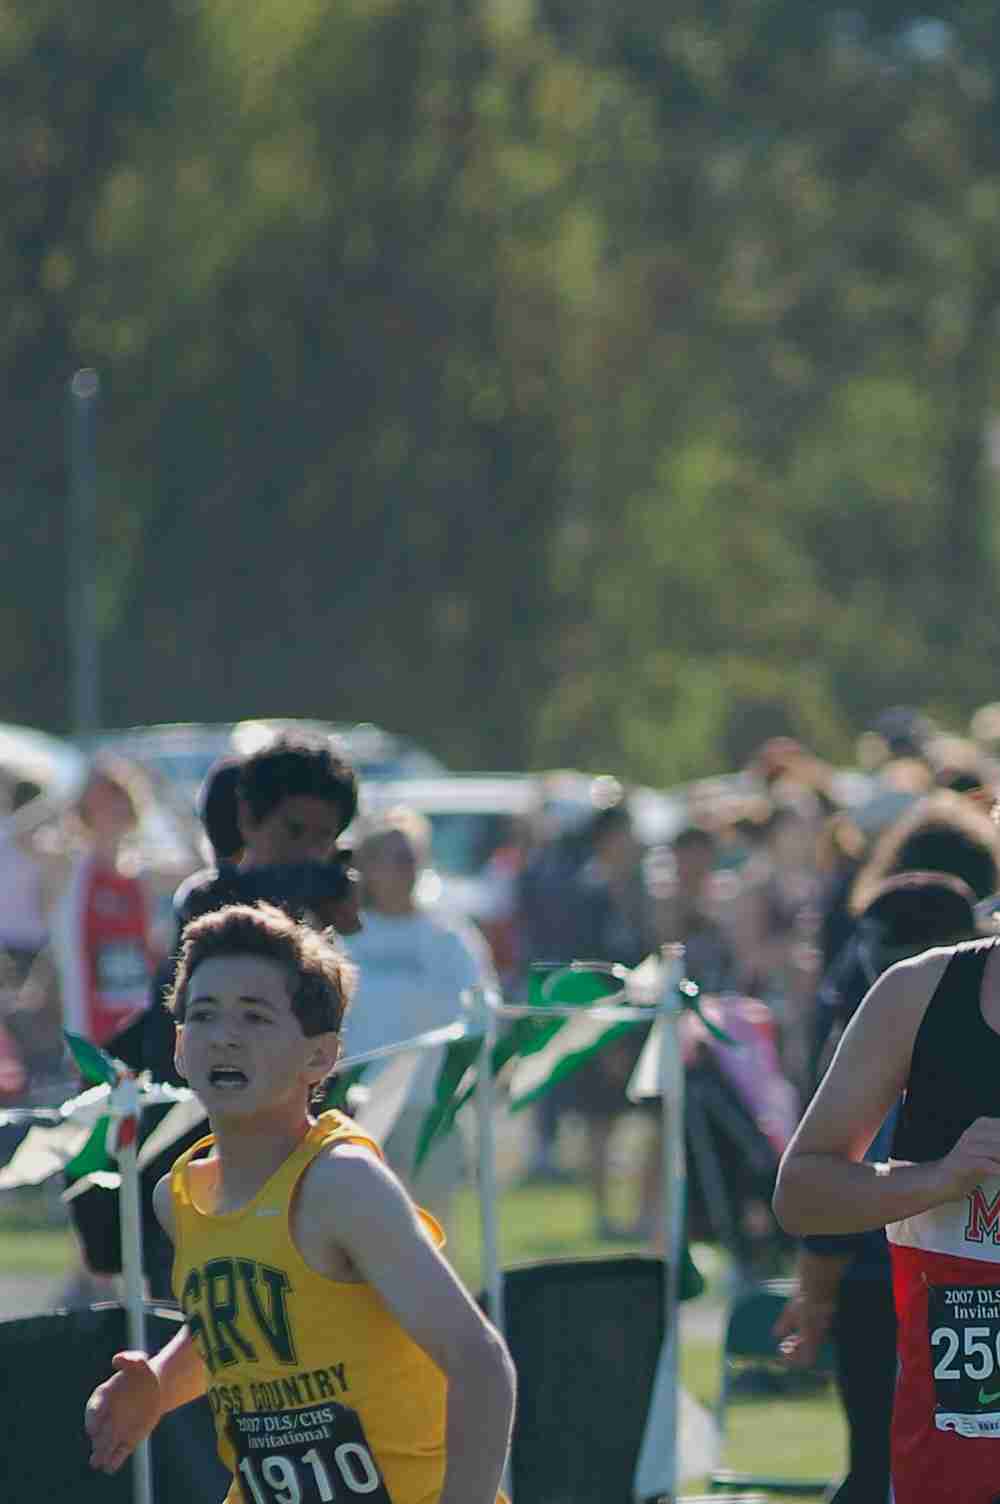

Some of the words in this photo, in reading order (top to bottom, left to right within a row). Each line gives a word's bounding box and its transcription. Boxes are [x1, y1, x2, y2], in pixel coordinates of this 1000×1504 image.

[945, 1290, 974, 1305] 2007
[250, 1362, 348, 1411] COUNTRY
[263, 1408, 334, 1432] DLS/CHS
